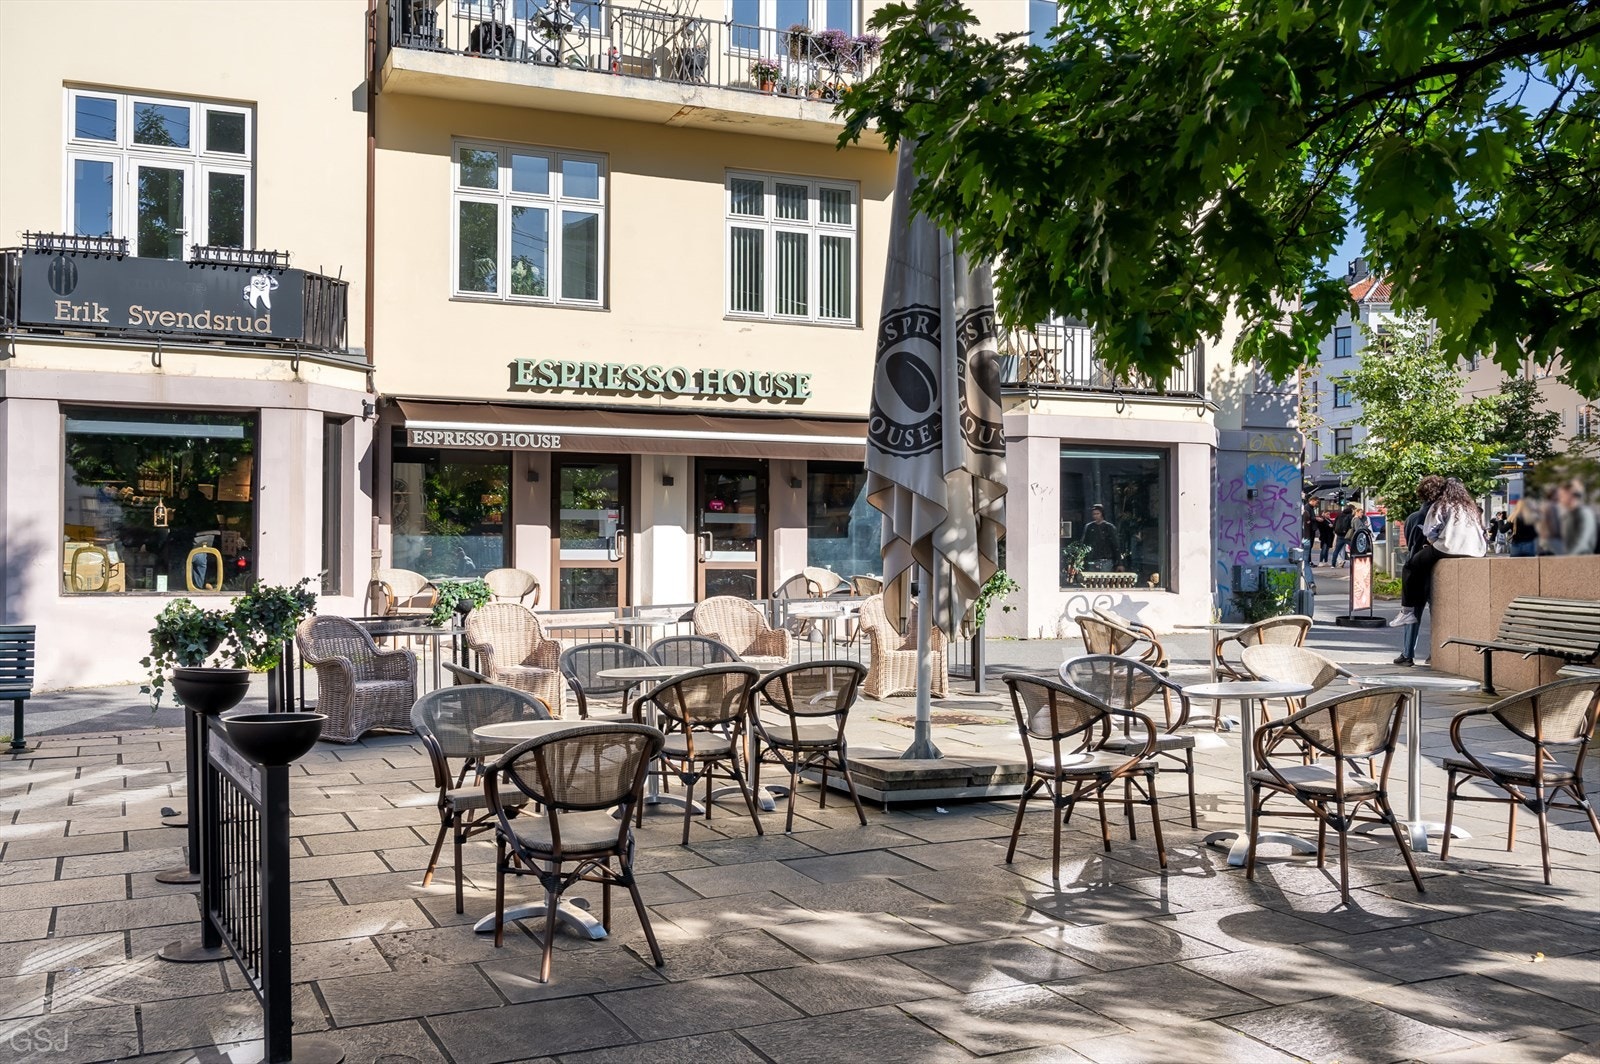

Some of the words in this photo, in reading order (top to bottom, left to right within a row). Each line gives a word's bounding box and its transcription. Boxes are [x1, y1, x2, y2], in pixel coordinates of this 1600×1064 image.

[55, 300, 110, 324] Erik
[128, 304, 273, 334] Svendsrud
[514, 357, 693, 394] ESPRESSO
[700, 367, 813, 399] HOUSE
[412, 430, 498, 447] ESPRESSO
[501, 432, 561, 449] HOUSE
[869, 407, 932, 448] OUSE
